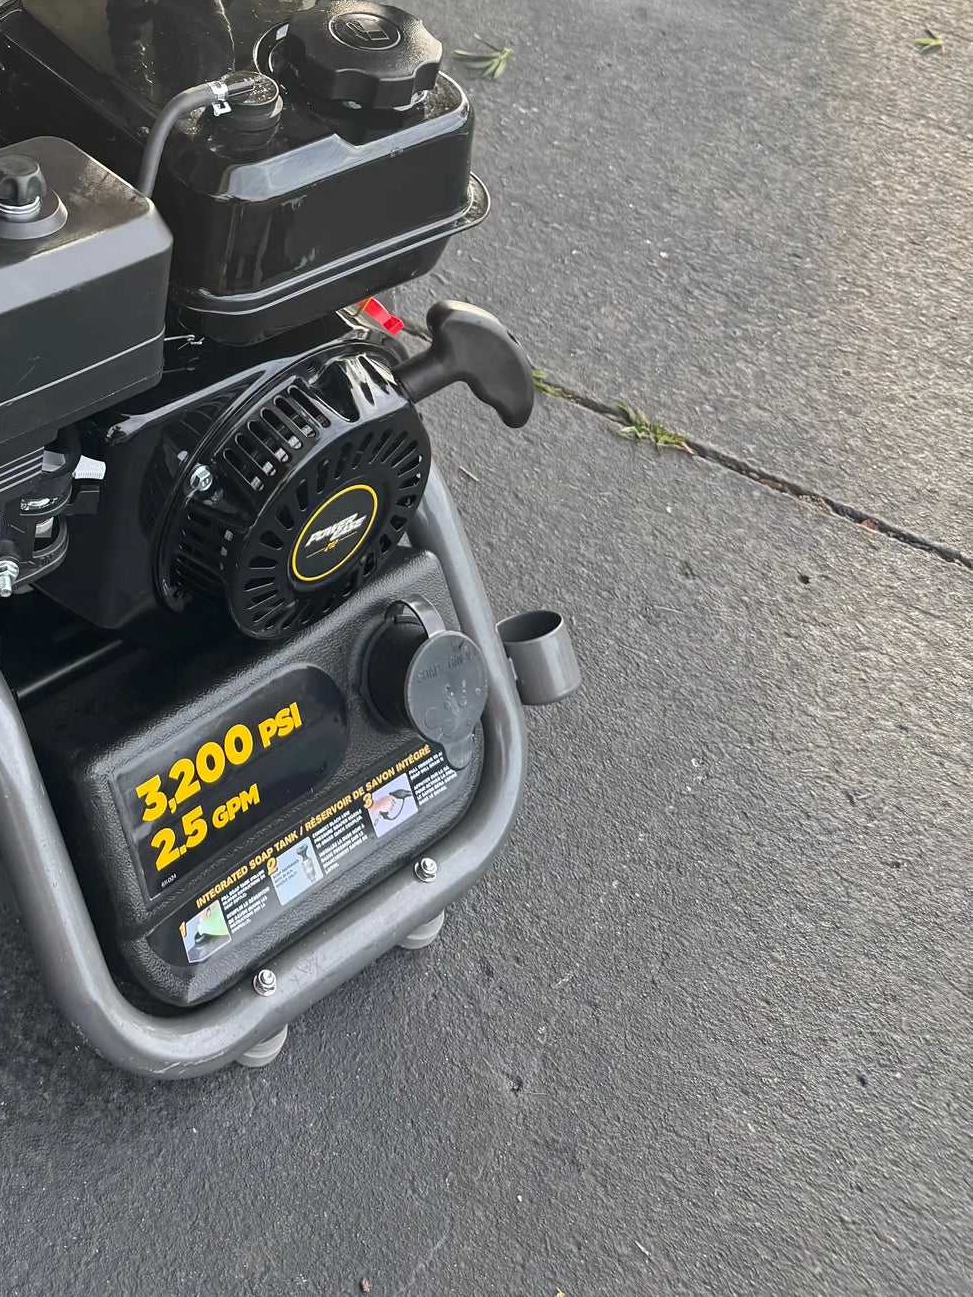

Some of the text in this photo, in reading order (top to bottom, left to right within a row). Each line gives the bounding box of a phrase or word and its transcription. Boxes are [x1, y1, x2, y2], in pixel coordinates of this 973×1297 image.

[136, 701, 303, 822] 3,200 PSI
[362, 792, 373, 809] 3
[150, 783, 261, 872] 2.5 GPM
[196, 866, 249, 908] INTEGRATED
[249, 848, 275, 869] SOAP
[274, 832, 299, 854] TANK
[352, 787, 365, 801] DE
[365, 767, 395, 793] SAVON
[395, 744, 432, 773] INTÉGRÉ
[267, 857, 277, 876] 2
